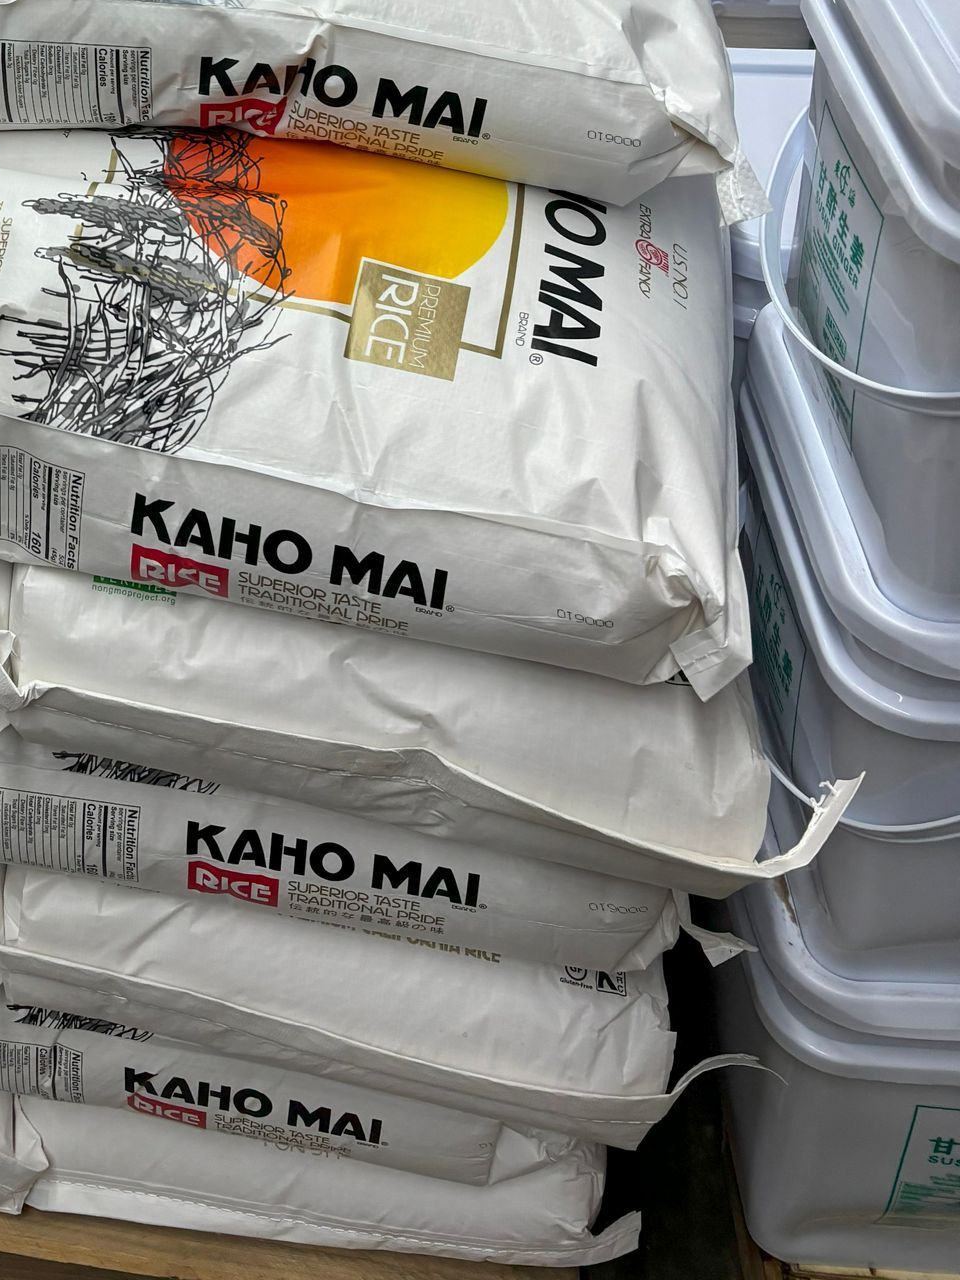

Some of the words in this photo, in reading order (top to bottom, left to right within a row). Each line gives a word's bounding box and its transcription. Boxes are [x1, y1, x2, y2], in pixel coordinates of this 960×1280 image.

[98, 48, 108, 87] Calories
[139, 50, 151, 104] Nutrition
[198, 56, 358, 107] KAHO
[372, 77, 488, 138] MAI
[287, 116, 390, 152] TRADITIONAL
[393, 141, 444, 161] PRIDE
[291, 100, 369, 135] SUPERIOR
[373, 126, 421, 144] TASTE
[639, 203, 651, 240] EXTRA
[638, 264, 651, 299] FANCY
[832, 235, 858, 289] GINGER
[364, 274, 419, 364] RICE
[409, 283, 441, 368] PREMIUM
[531, 243, 605, 367] MAI
[516, 312, 529, 347] BRAND
[32, 460, 41, 499] Calories
[60, 471, 68, 496] servings
[68, 474, 82, 531] Nutrition
[30, 531, 42, 554] 160
[66, 534, 78, 569] Facts
[130, 492, 313, 574] KAHO
[329, 544, 448, 611] MAI
[91, 584, 176, 606] nongmoproject.org
[139, 559, 221, 594] RICE
[239, 572, 328, 601] SUPERIOR
[331, 592, 382, 614] TASTE
[238, 584, 352, 619] TRADITIONAL
[356, 610, 409, 631] PRIDE
[86, 803, 96, 841] Calories
[125, 808, 138, 860] Nutrition
[185, 821, 355, 882] KAHO
[371, 854, 481, 908] MAI
[195, 868, 272, 903] RICE
[288, 881, 369, 904] SUPERIOR
[373, 895, 420, 913] TASTE
[287, 891, 395, 919] TRADITIONAL
[398, 911, 445, 927] PRIDE
[560, 977, 592, 990] Gluten-Free
[71, 1052, 81, 1090] Nutrition
[124, 1067, 273, 1118] KAHO
[286, 1099, 383, 1146] MAI
[134, 1098, 201, 1125] RICE
[215, 1113, 286, 1135] SUPERIOR
[289, 1130, 330, 1143] TASTE
[214, 1121, 306, 1148] TRADITIONAL
